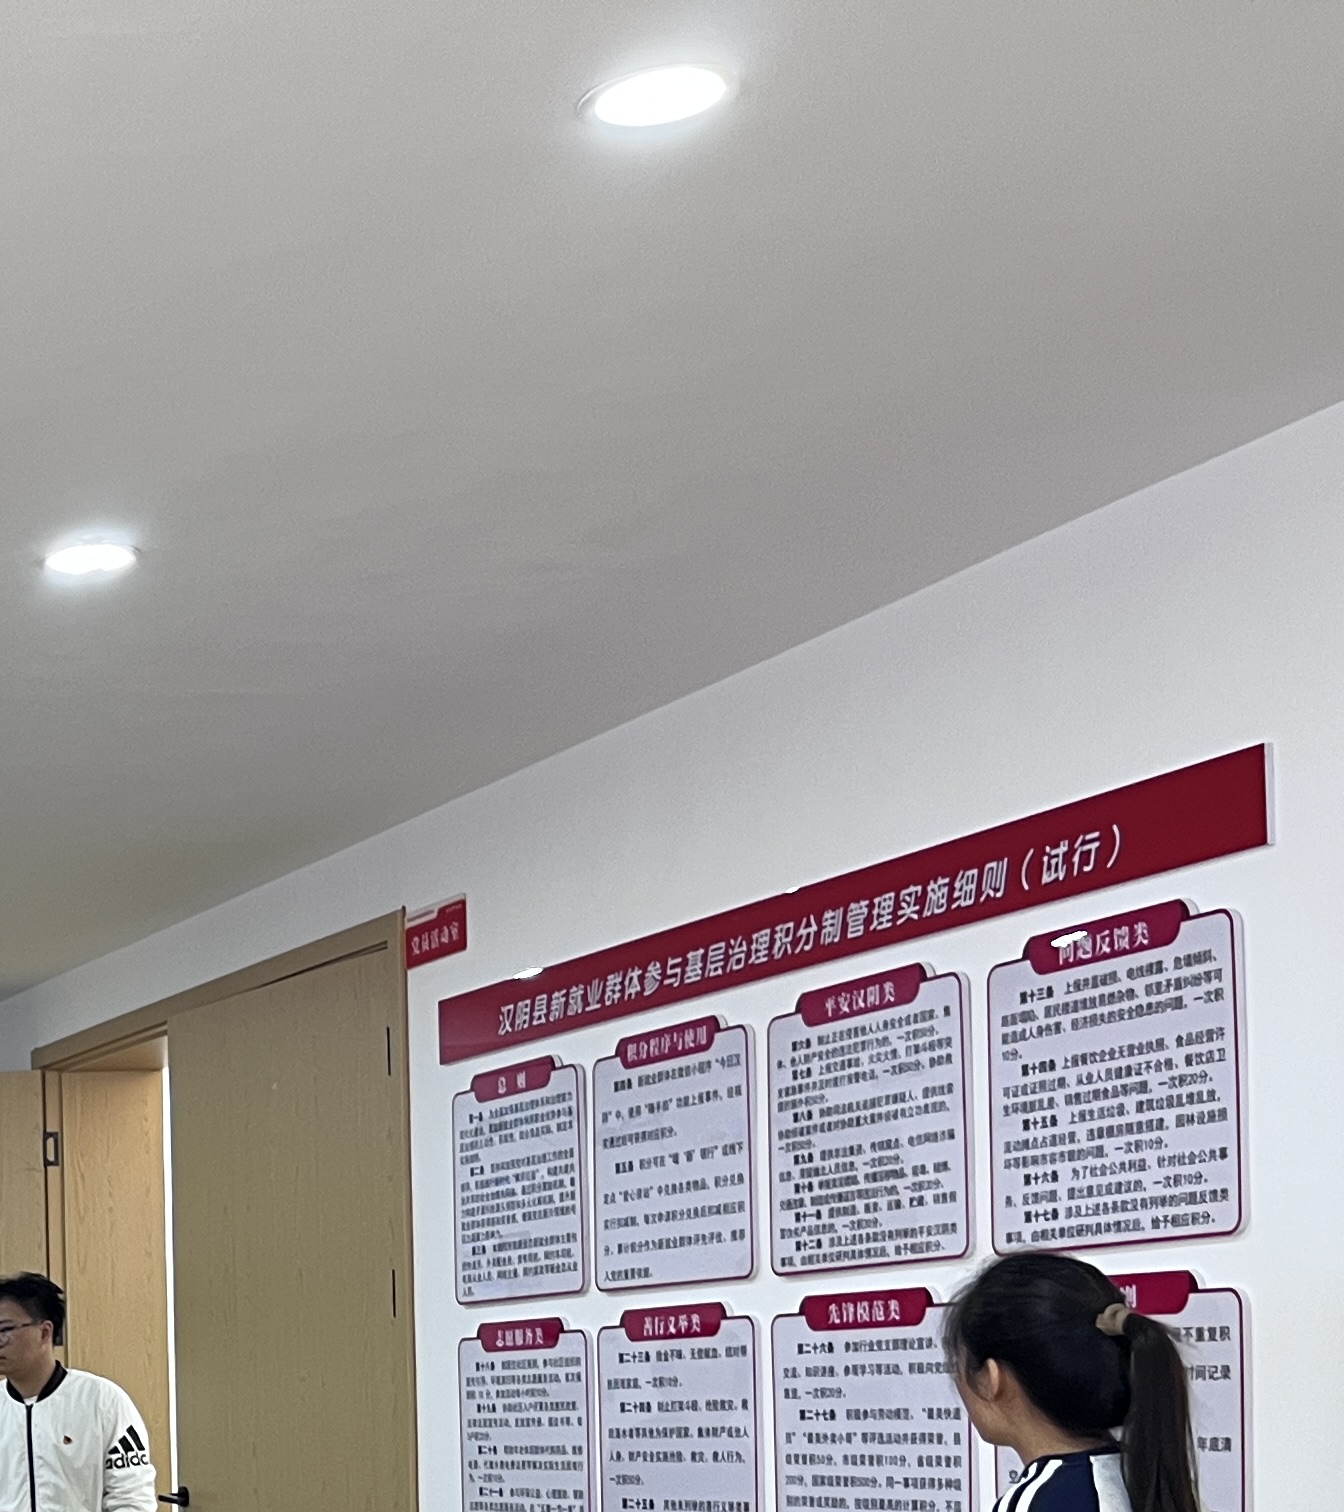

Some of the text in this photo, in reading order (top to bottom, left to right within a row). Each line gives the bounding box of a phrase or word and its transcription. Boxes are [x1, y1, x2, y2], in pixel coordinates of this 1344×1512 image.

[496, 824, 1127, 1037] 汉阴县新就业群体参与基层治理积分制管理实施细则（试行）
[1057, 921, 1149, 966] 问题反馈类
[824, 981, 897, 1018] 平安汉阴类
[626, 1024, 708, 1063] 积分程序与使用
